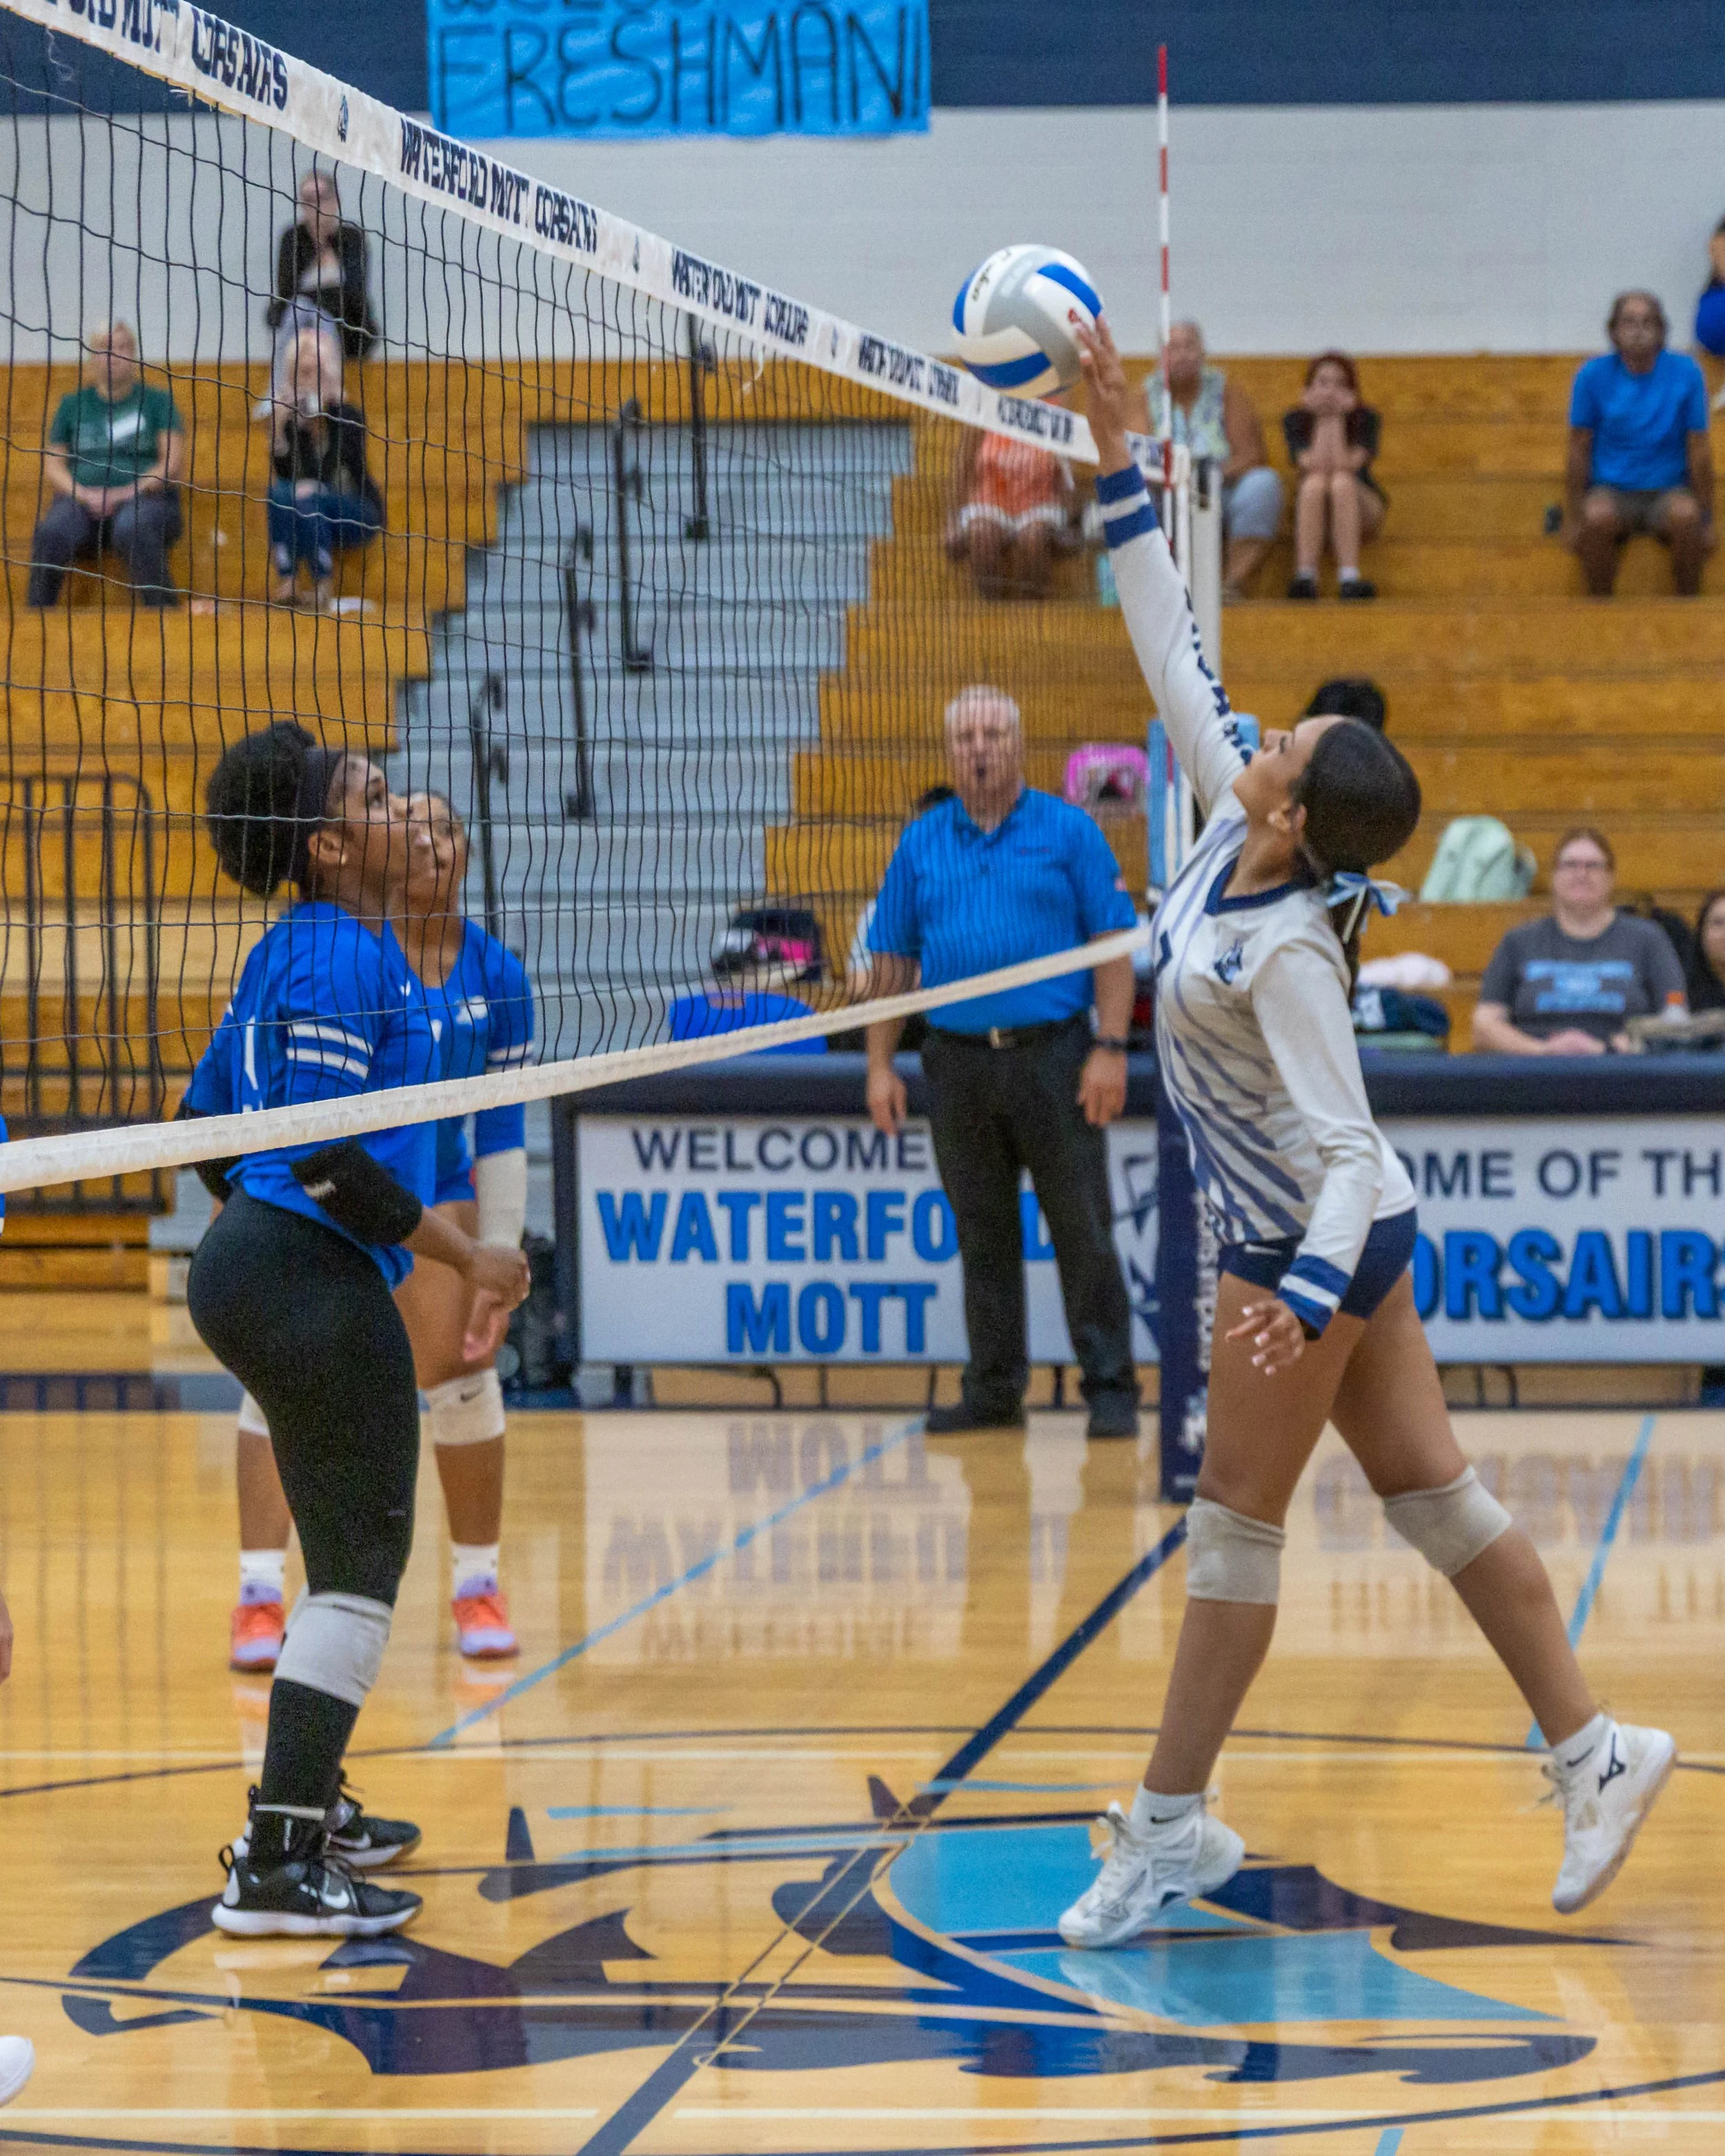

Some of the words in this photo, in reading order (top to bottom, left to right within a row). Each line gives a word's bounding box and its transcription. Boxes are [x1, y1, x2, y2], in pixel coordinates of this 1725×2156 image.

[632, 1128, 927, 1171] WELCOME
[1537, 1149, 1621, 1199] OF
[725, 1281, 937, 1354] MOTT
